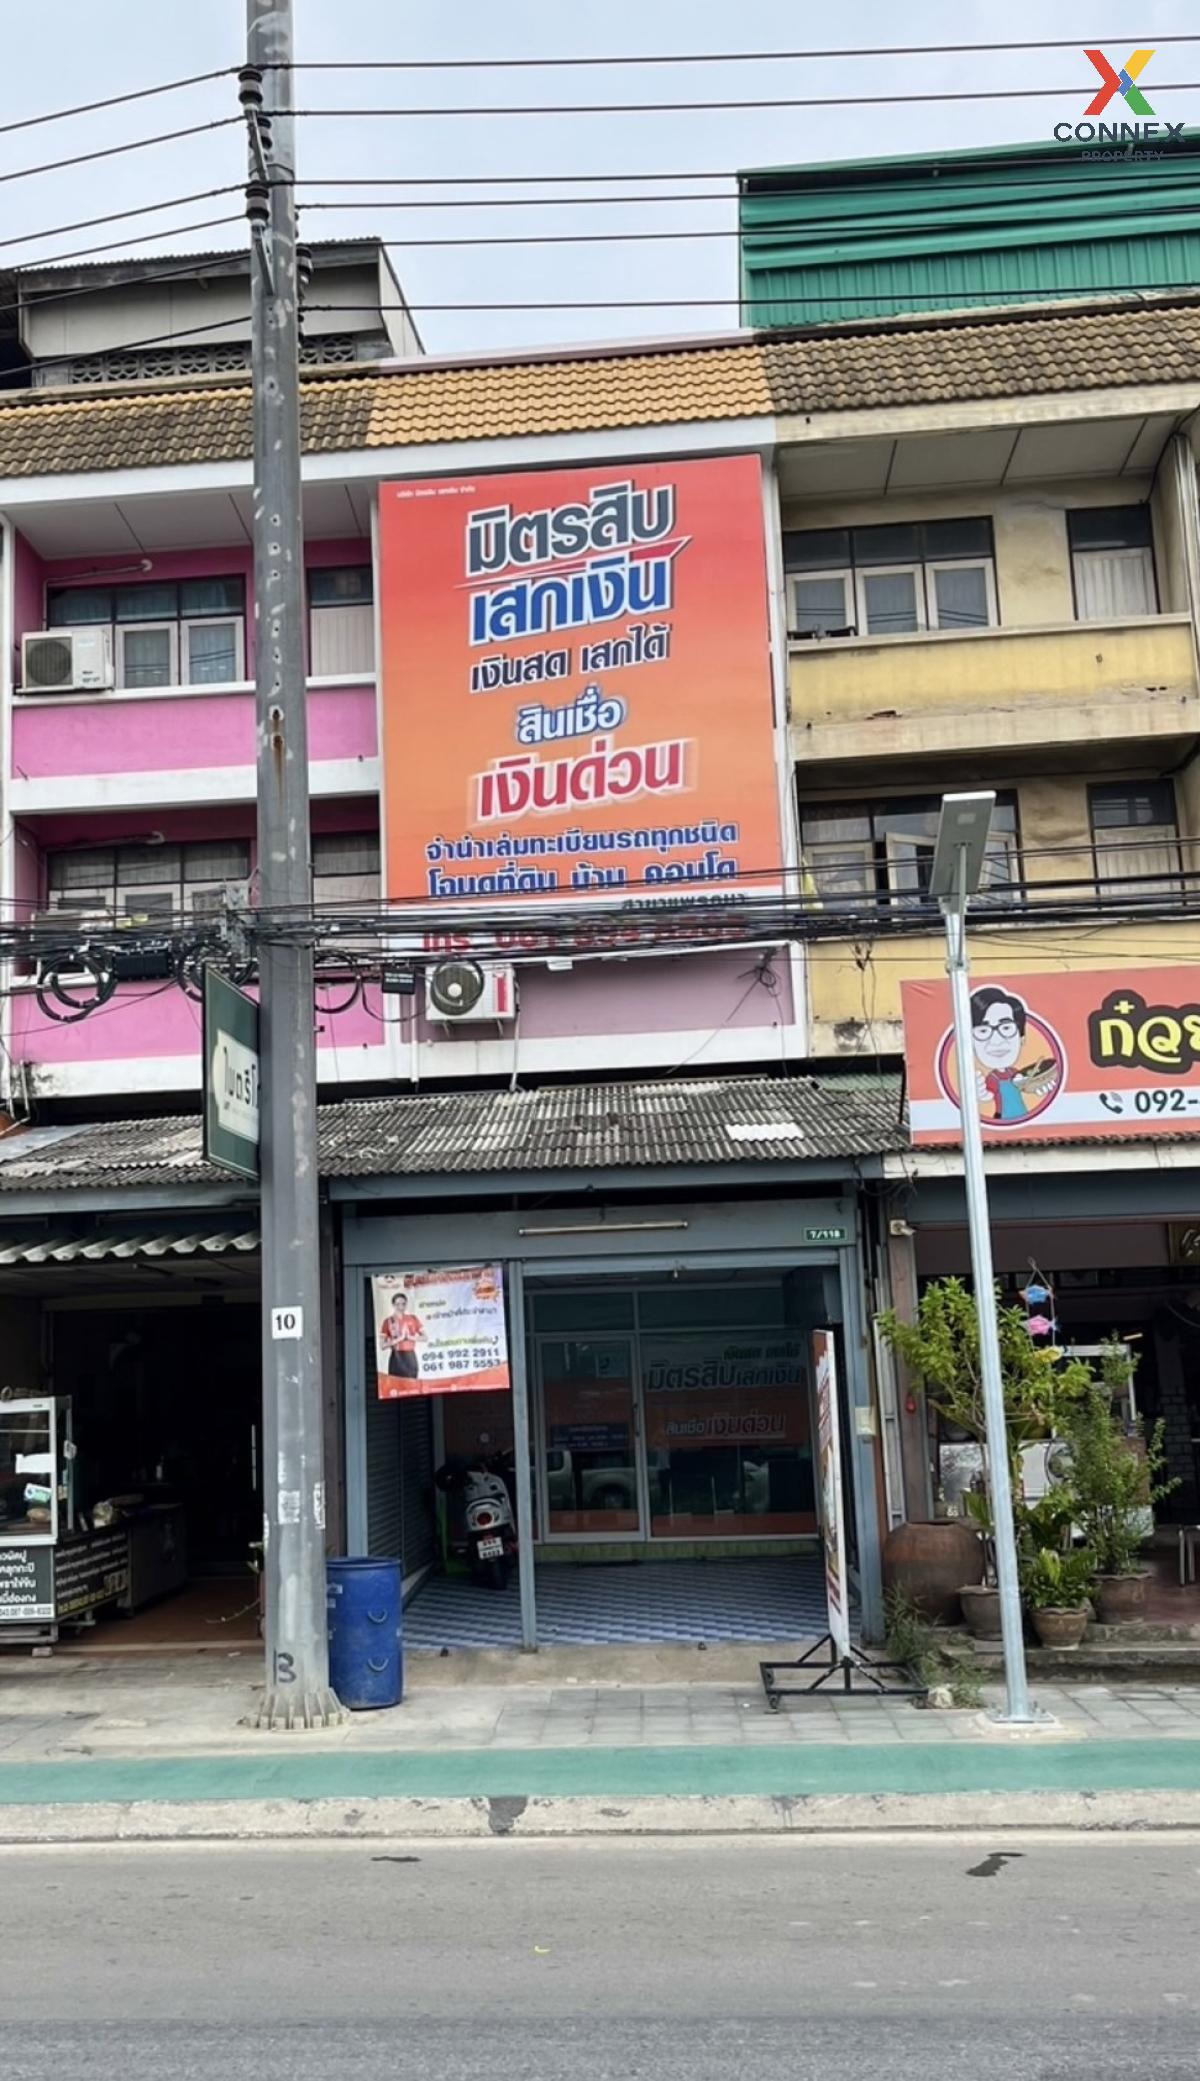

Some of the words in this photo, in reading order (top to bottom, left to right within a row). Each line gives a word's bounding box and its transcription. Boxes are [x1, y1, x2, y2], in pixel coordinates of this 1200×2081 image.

[467, 481, 675, 577] มิตรสิบ
[470, 554, 671, 645] เสกเงิน
[471, 649, 568, 692] เงินสด
[581, 624, 669, 672] เสกได้
[518, 687, 624, 744] สินเชื่อ
[479, 736, 684, 819] เงินด่วน
[427, 820, 738, 861] จำนำเล่มทะเบียนรถทุกชนิด
[572, 862, 625, 889] บ้าน
[1135, 1090, 1198, 1114] 092-
[276, 1314, 296, 1331] 10
[448, 1349, 469, 1358] 992
[473, 1348, 499, 1357] 2911
[449, 1360, 470, 1369] 987
